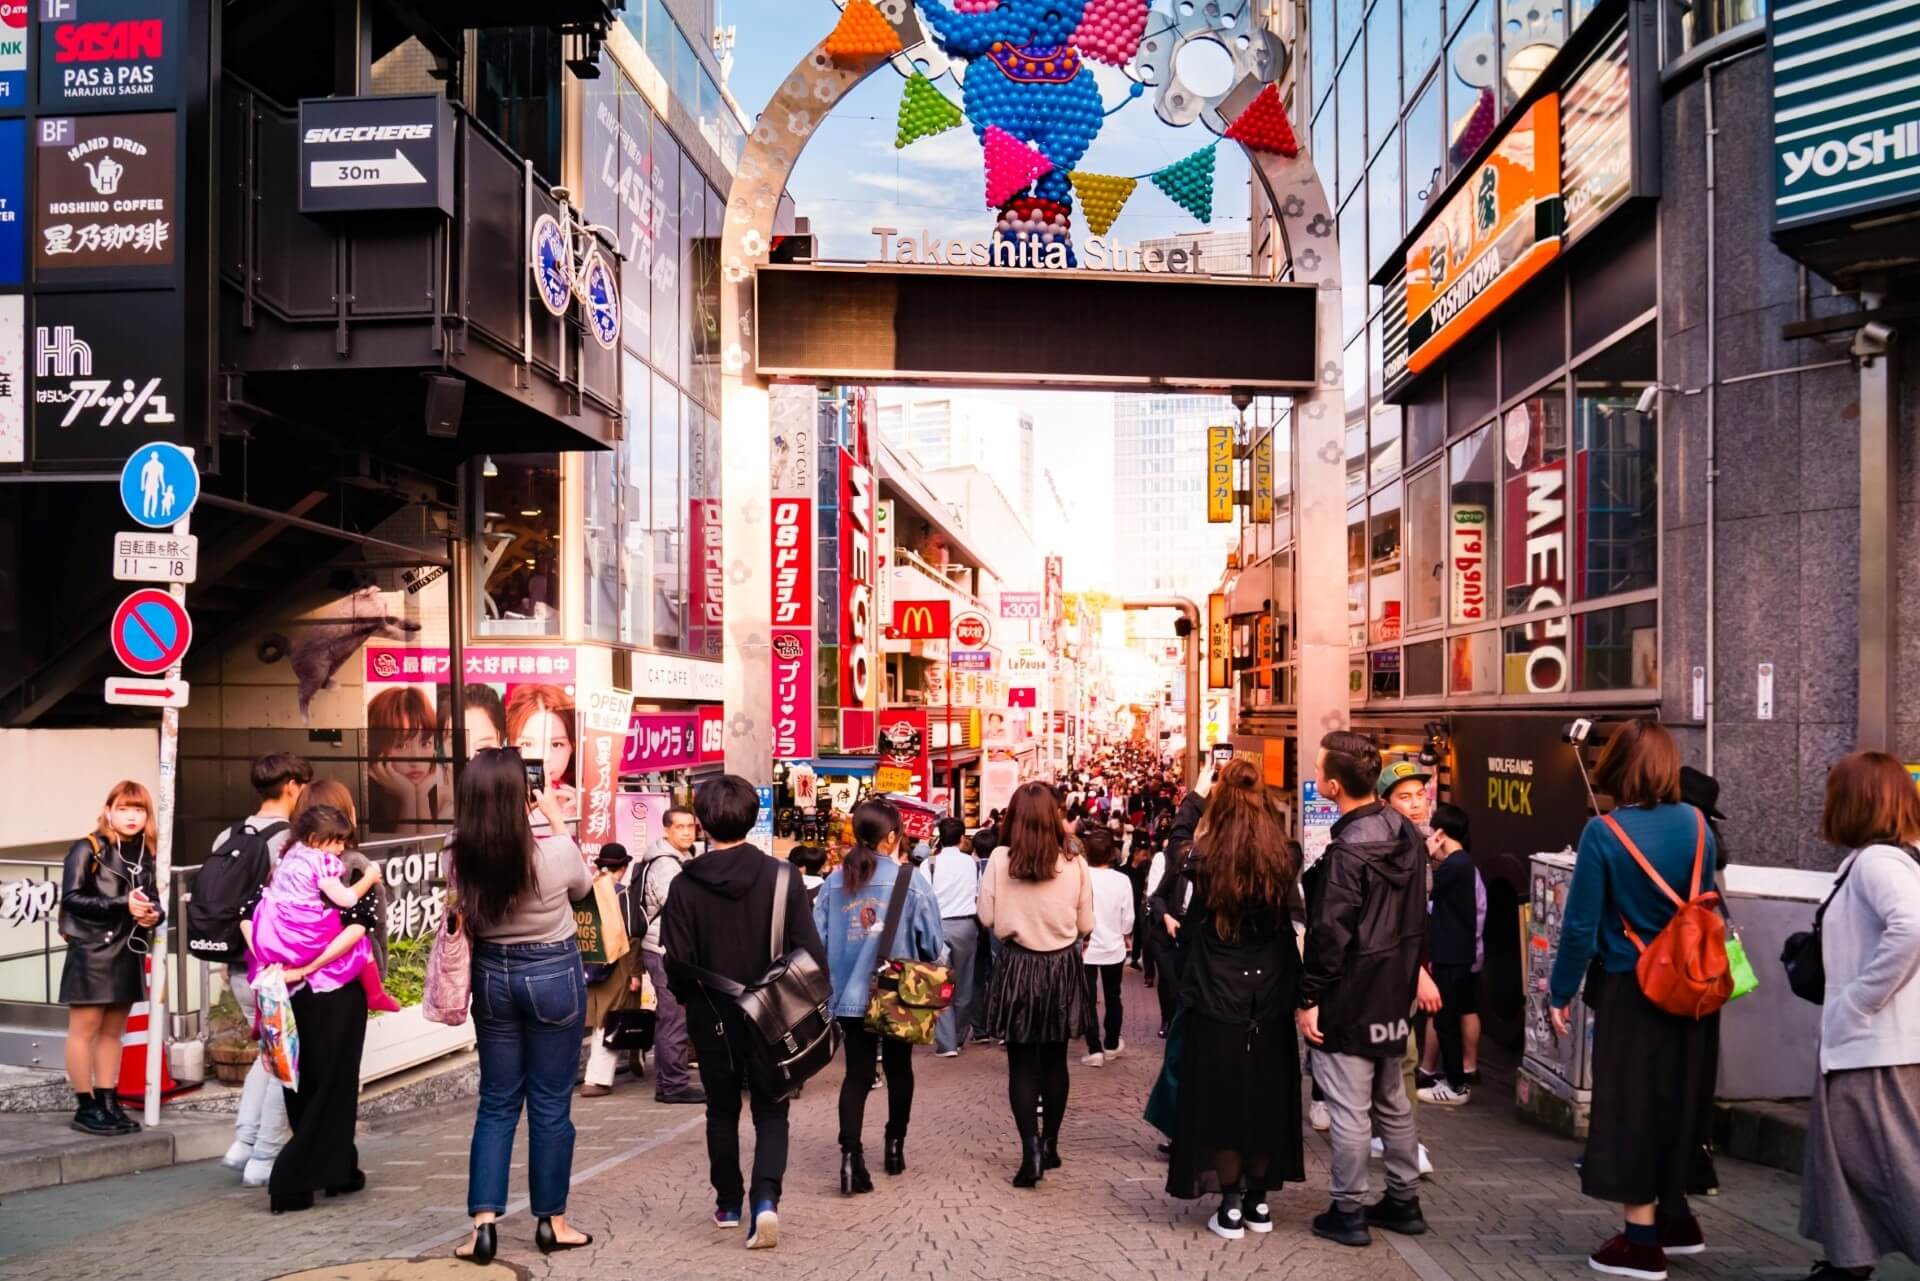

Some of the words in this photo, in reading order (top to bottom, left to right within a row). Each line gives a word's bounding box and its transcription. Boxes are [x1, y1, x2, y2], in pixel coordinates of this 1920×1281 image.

[64, 69, 98, 86] PAS
[103, 67, 113, 84] à
[118, 65, 153, 83] PAS
[64, 87, 115, 97] HARAJUKU
[118, 85, 153, 95] SASAKI
[43, 121, 68, 142] BF
[303, 124, 433, 144] SKECHERS
[67, 138, 109, 161] HAND
[112, 137, 147, 157] DRIP
[1782, 120, 1920, 186] YOSHI
[338, 165, 380, 181] 30m
[601, 143, 665, 237] LASER
[50, 201, 108, 214] HOSHINO
[113, 199, 163, 213] COFFEE
[44, 219, 170, 256] 星乃珈琲
[629, 221, 678, 292] TRAP
[872, 227, 1068, 269] Takeshita
[1083, 236, 1203, 274] Street
[1430, 247, 1500, 333] YOSHINOYA
[60, 377, 176, 427] アッシュ
[1213, 429, 1230, 511] コインロッカー
[119, 540, 190, 556] 自転車を除く
[122, 559, 138, 574] 11
[168, 561, 184, 577] 18
[589, 693, 629, 713] OPEN
[1488, 757, 1533, 775] WOLFGANG
[1488, 777, 1533, 816] PUCK
[190, 939, 228, 951] adidas
